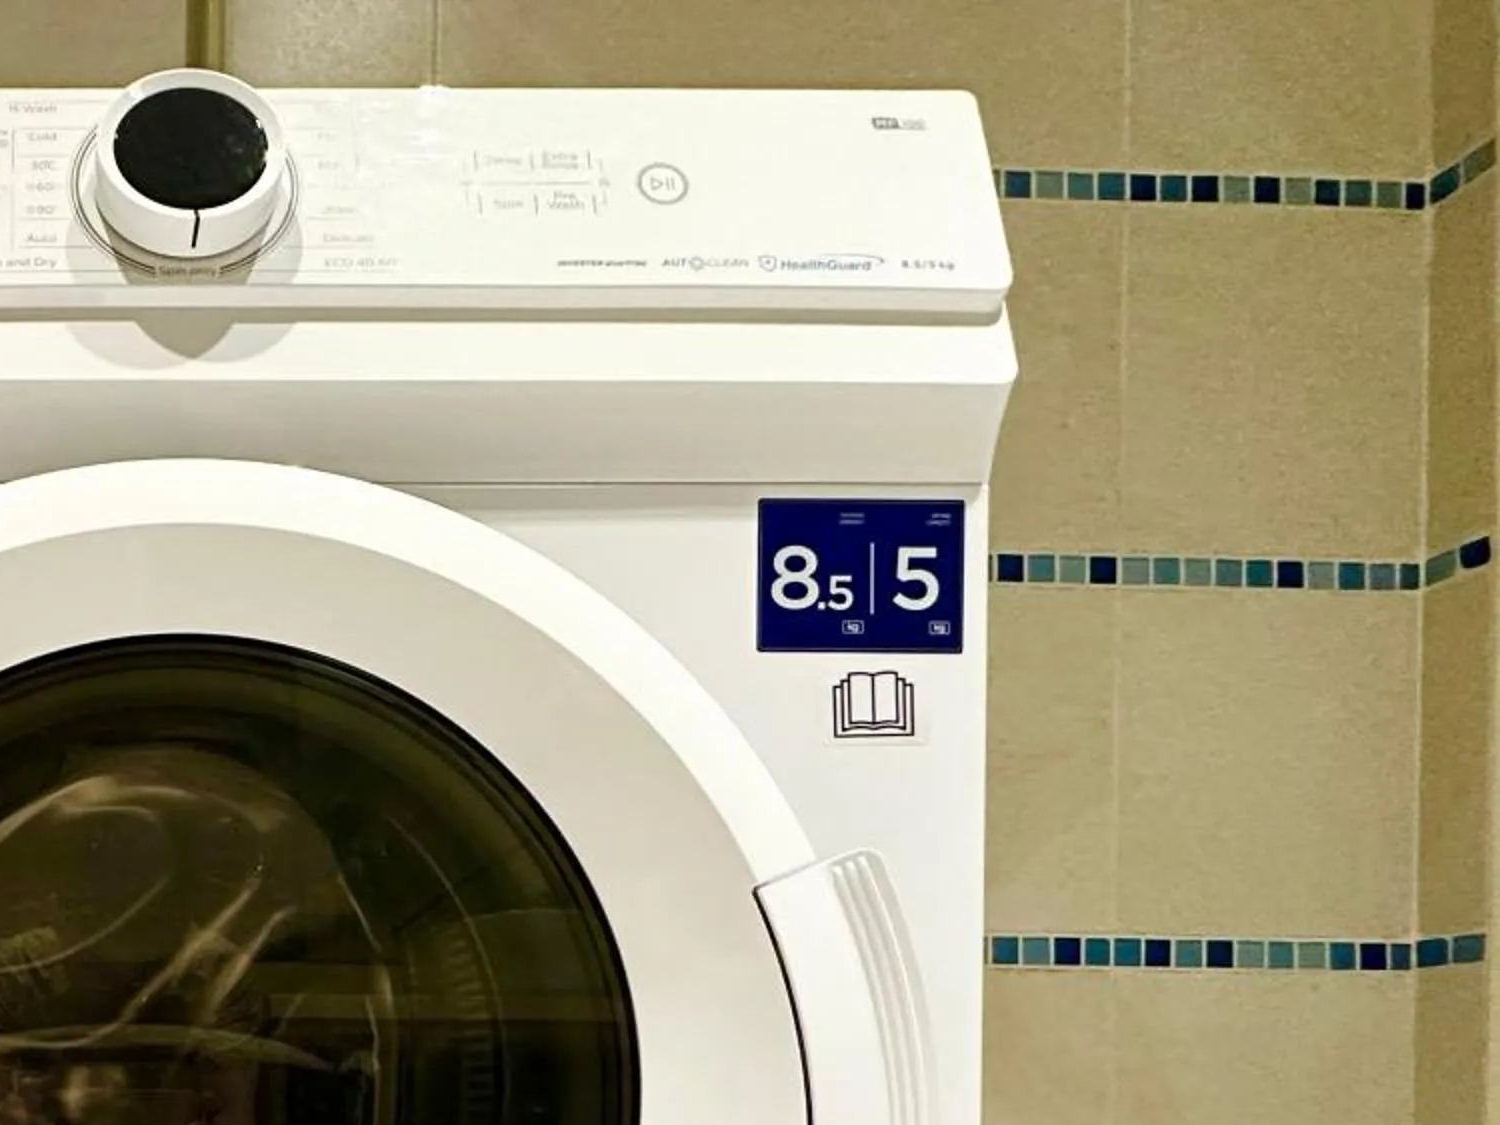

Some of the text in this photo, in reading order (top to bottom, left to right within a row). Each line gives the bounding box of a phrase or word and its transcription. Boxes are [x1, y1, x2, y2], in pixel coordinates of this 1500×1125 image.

[6, 258, 31, 267] and
[33, 257, 58, 269] Dry
[780, 259, 872, 272] HealthGuard
[770, 545, 854, 611] 8.5
[892, 546, 940, 611] 5
